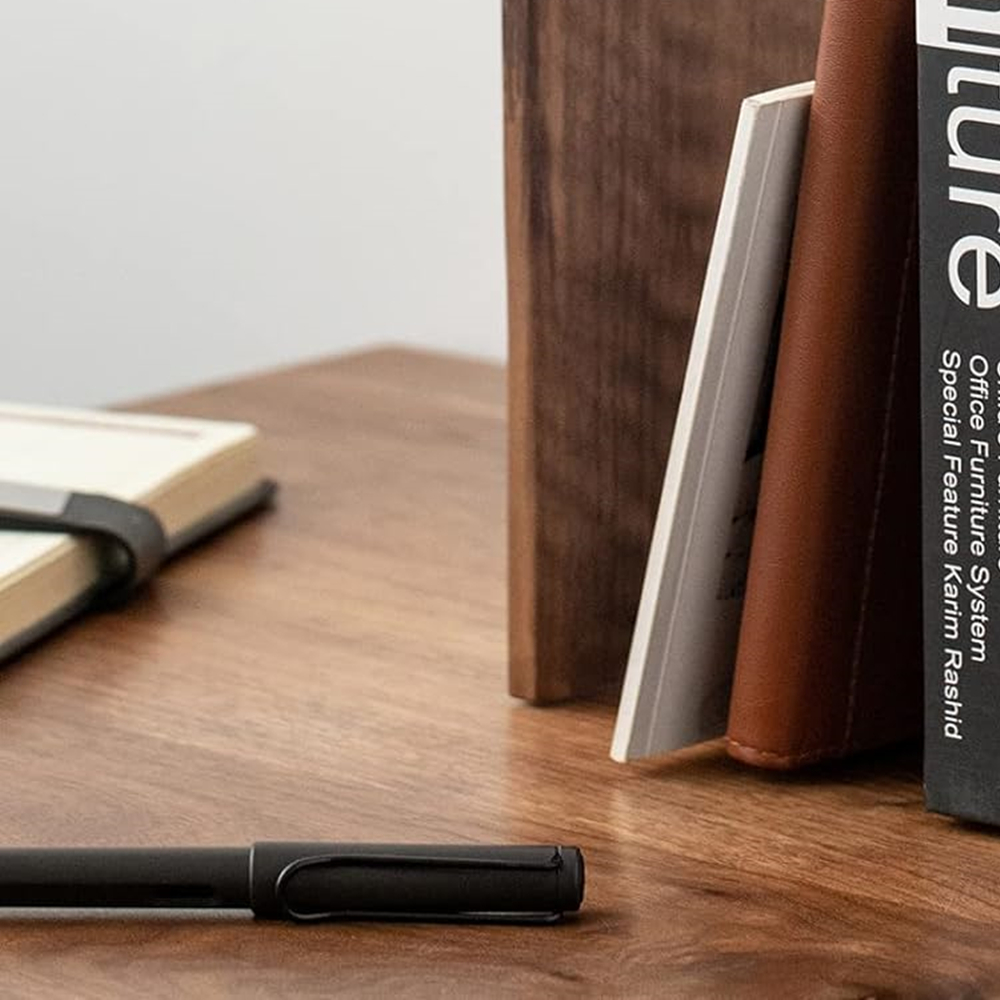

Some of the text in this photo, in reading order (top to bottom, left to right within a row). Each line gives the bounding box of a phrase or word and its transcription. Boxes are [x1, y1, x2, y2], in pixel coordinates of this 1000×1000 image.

[938, 349, 963, 740] Special Feature Karim Rashid
[966, 354, 990, 663] Office Furniture System
